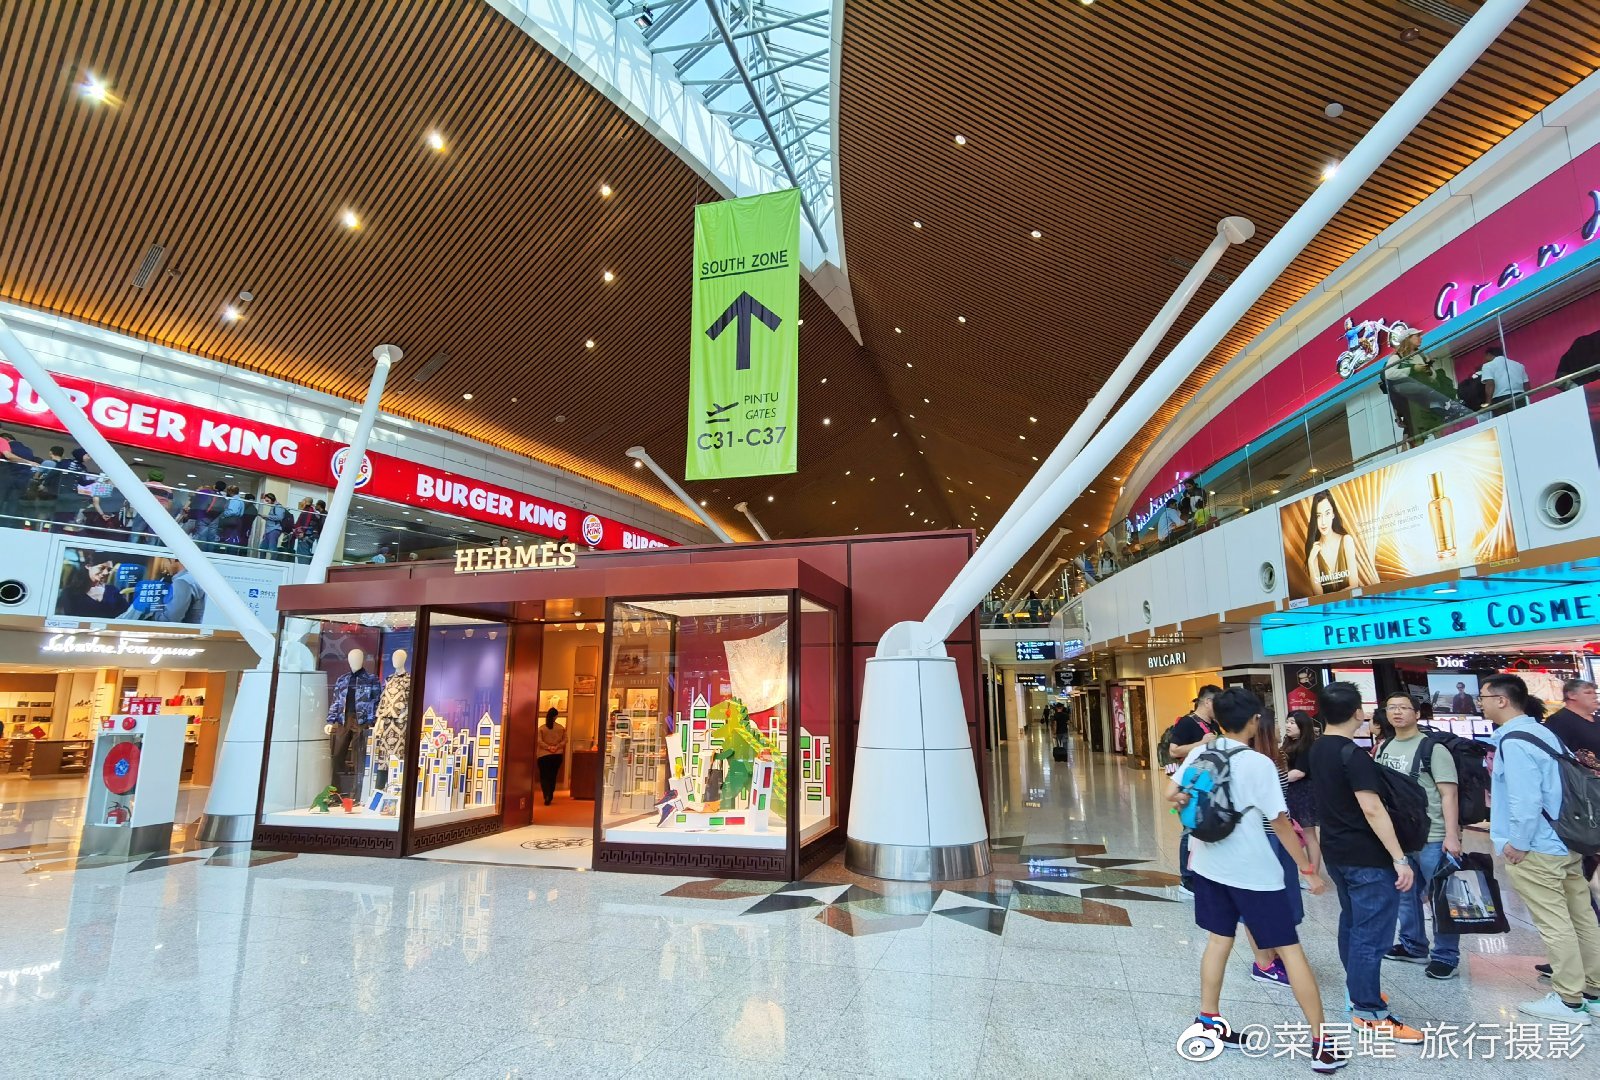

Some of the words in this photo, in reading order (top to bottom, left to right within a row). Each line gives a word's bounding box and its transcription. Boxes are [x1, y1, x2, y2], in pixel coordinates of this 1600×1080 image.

[701, 256, 745, 276] SOUTH
[751, 250, 788, 268] ZONE
[744, 392, 779, 404] PINTU
[745, 408, 777, 420] GATES
[199, 419, 298, 466] KING
[697, 426, 787, 450] C31-C37
[416, 473, 513, 518] BURGER
[519, 503, 567, 531] KING
[622, 531, 669, 550] BURG
[1324, 615, 1432, 646] PERFUMES
[1451, 611, 1467, 632] &
[1487, 593, 1600, 629] COSME
[1148, 651, 1186, 669] BVLGARI
[1435, 656, 1466, 668] Dior
